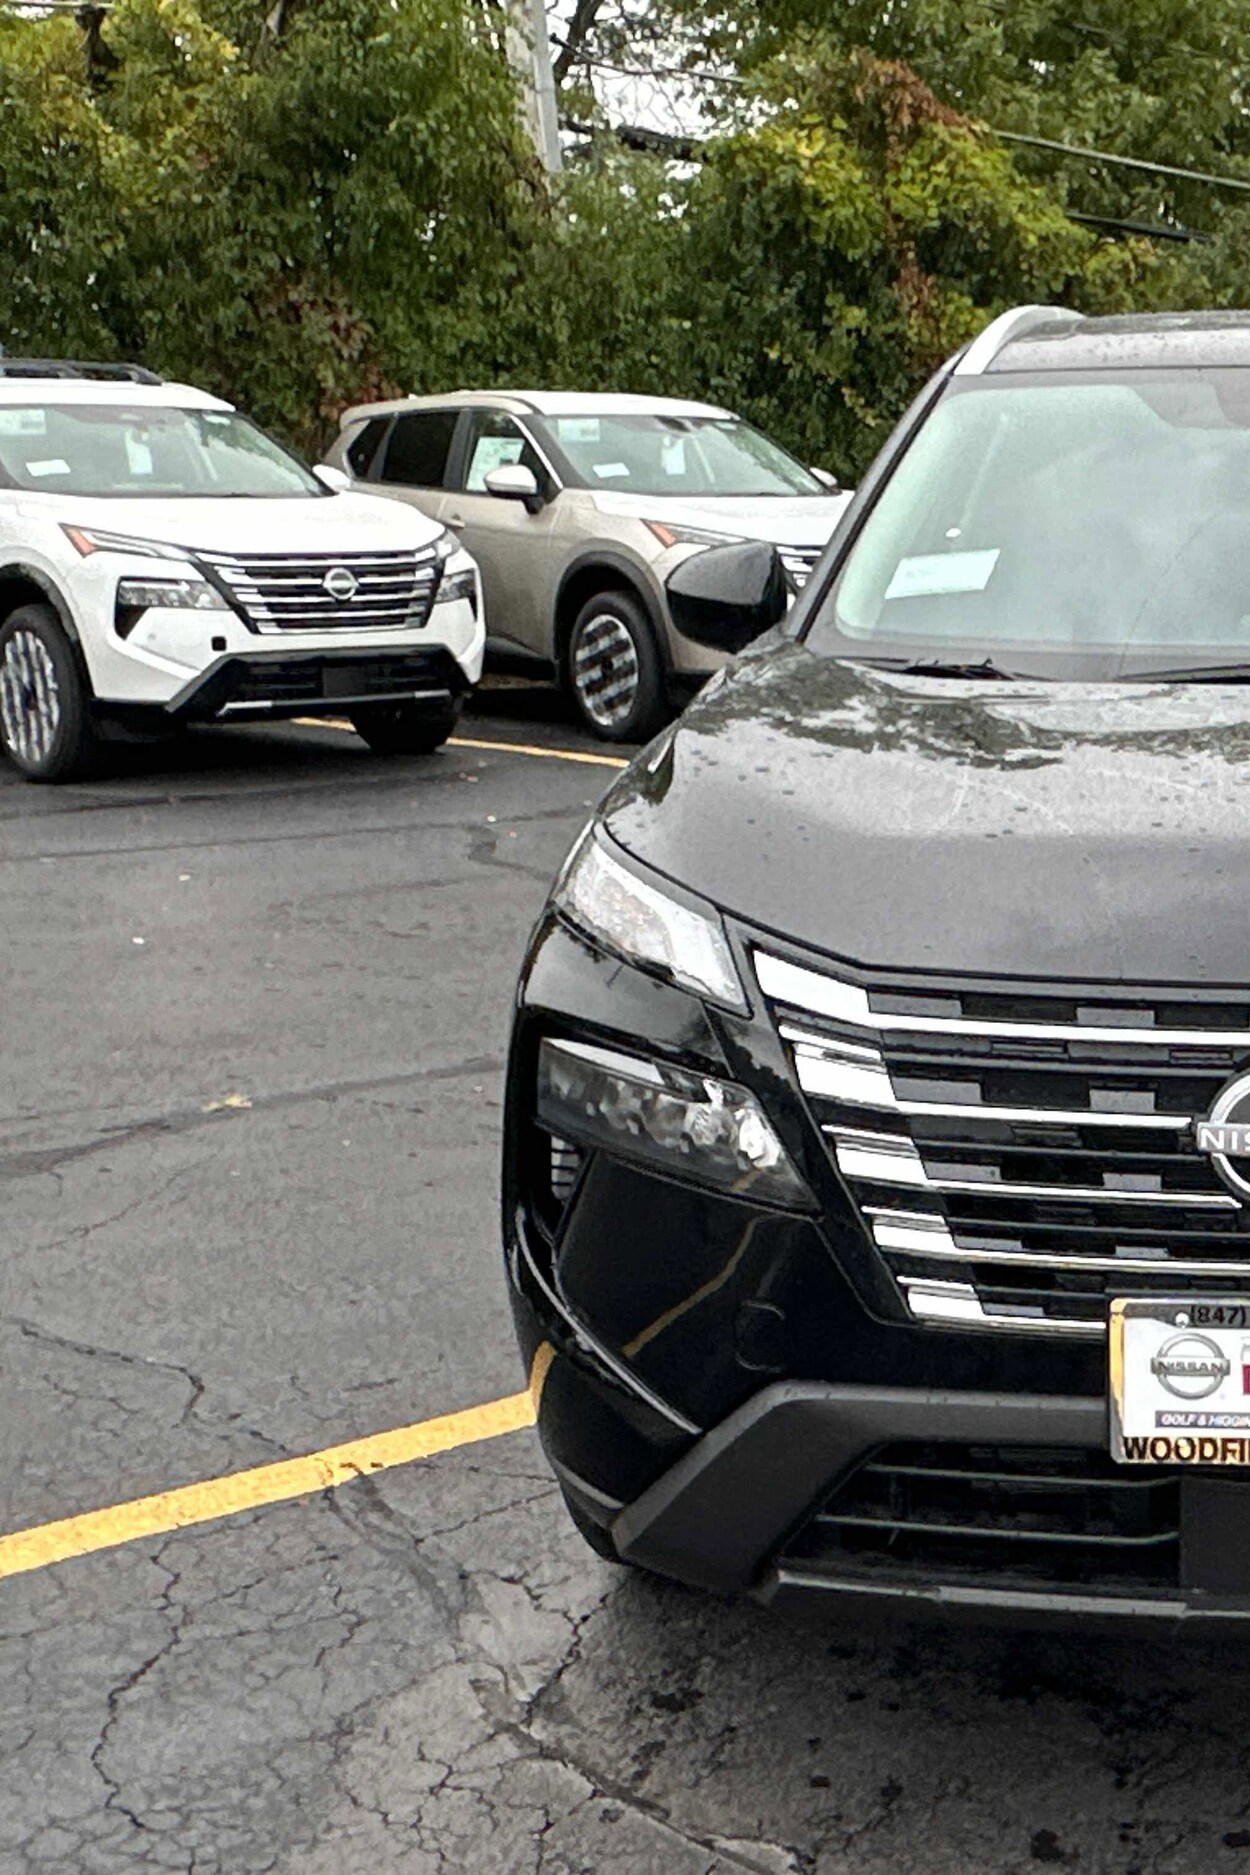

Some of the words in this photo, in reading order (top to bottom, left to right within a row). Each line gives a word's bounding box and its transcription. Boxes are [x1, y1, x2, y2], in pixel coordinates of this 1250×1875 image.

[1190, 1305, 1246, 1327] (847)
[1157, 1360, 1224, 1374] NISSAN
[1161, 1413, 1196, 1426] GOLF
